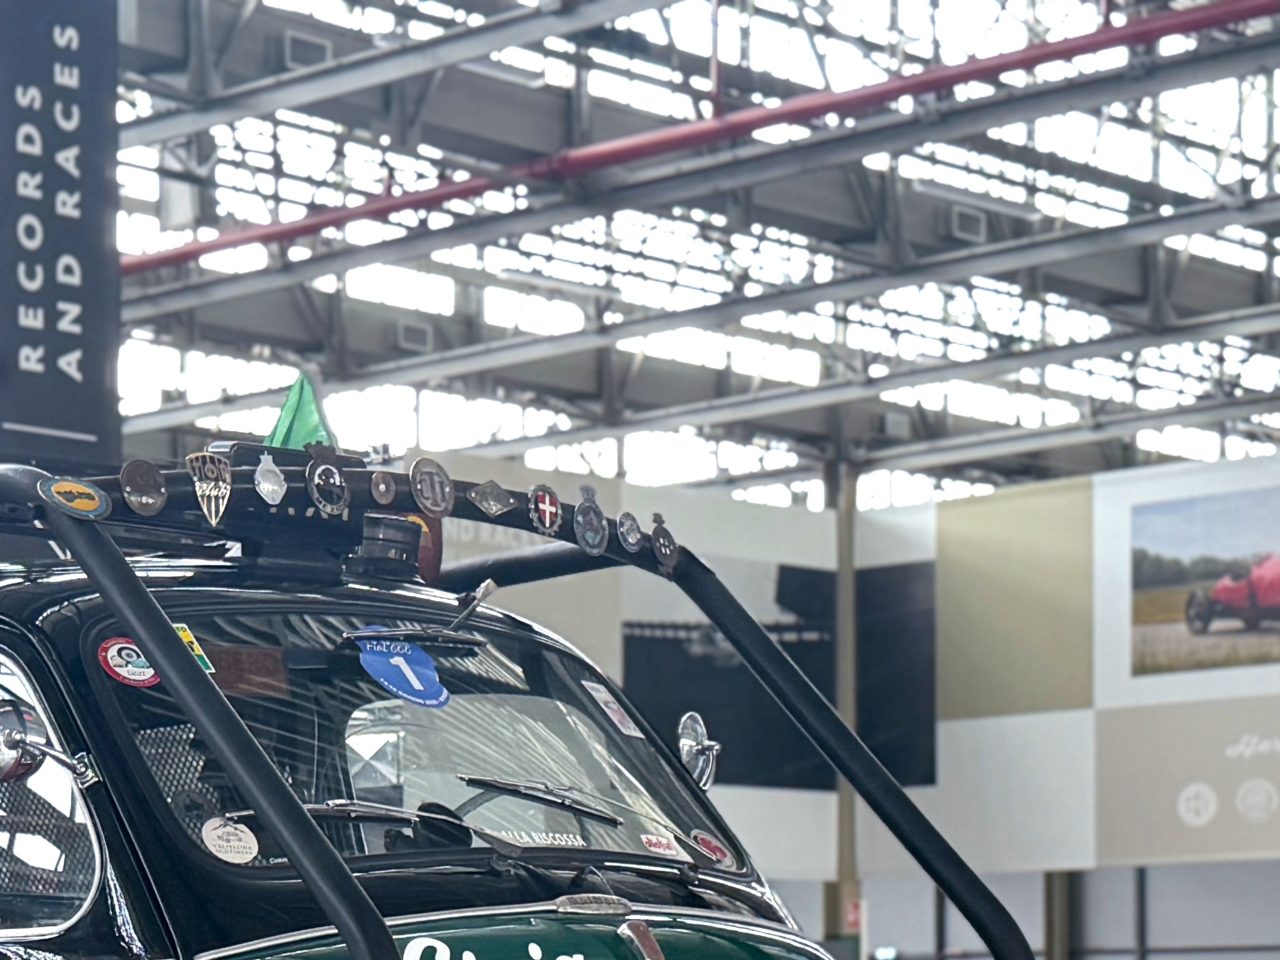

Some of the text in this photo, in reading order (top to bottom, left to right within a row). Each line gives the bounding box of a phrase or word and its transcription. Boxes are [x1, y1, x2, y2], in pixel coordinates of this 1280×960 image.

[16, 85, 45, 373] RECORDS
[54, 24, 83, 383] AND RACES
[389, 656, 425, 691] 1
[532, 831, 587, 847] RISCOSSA
